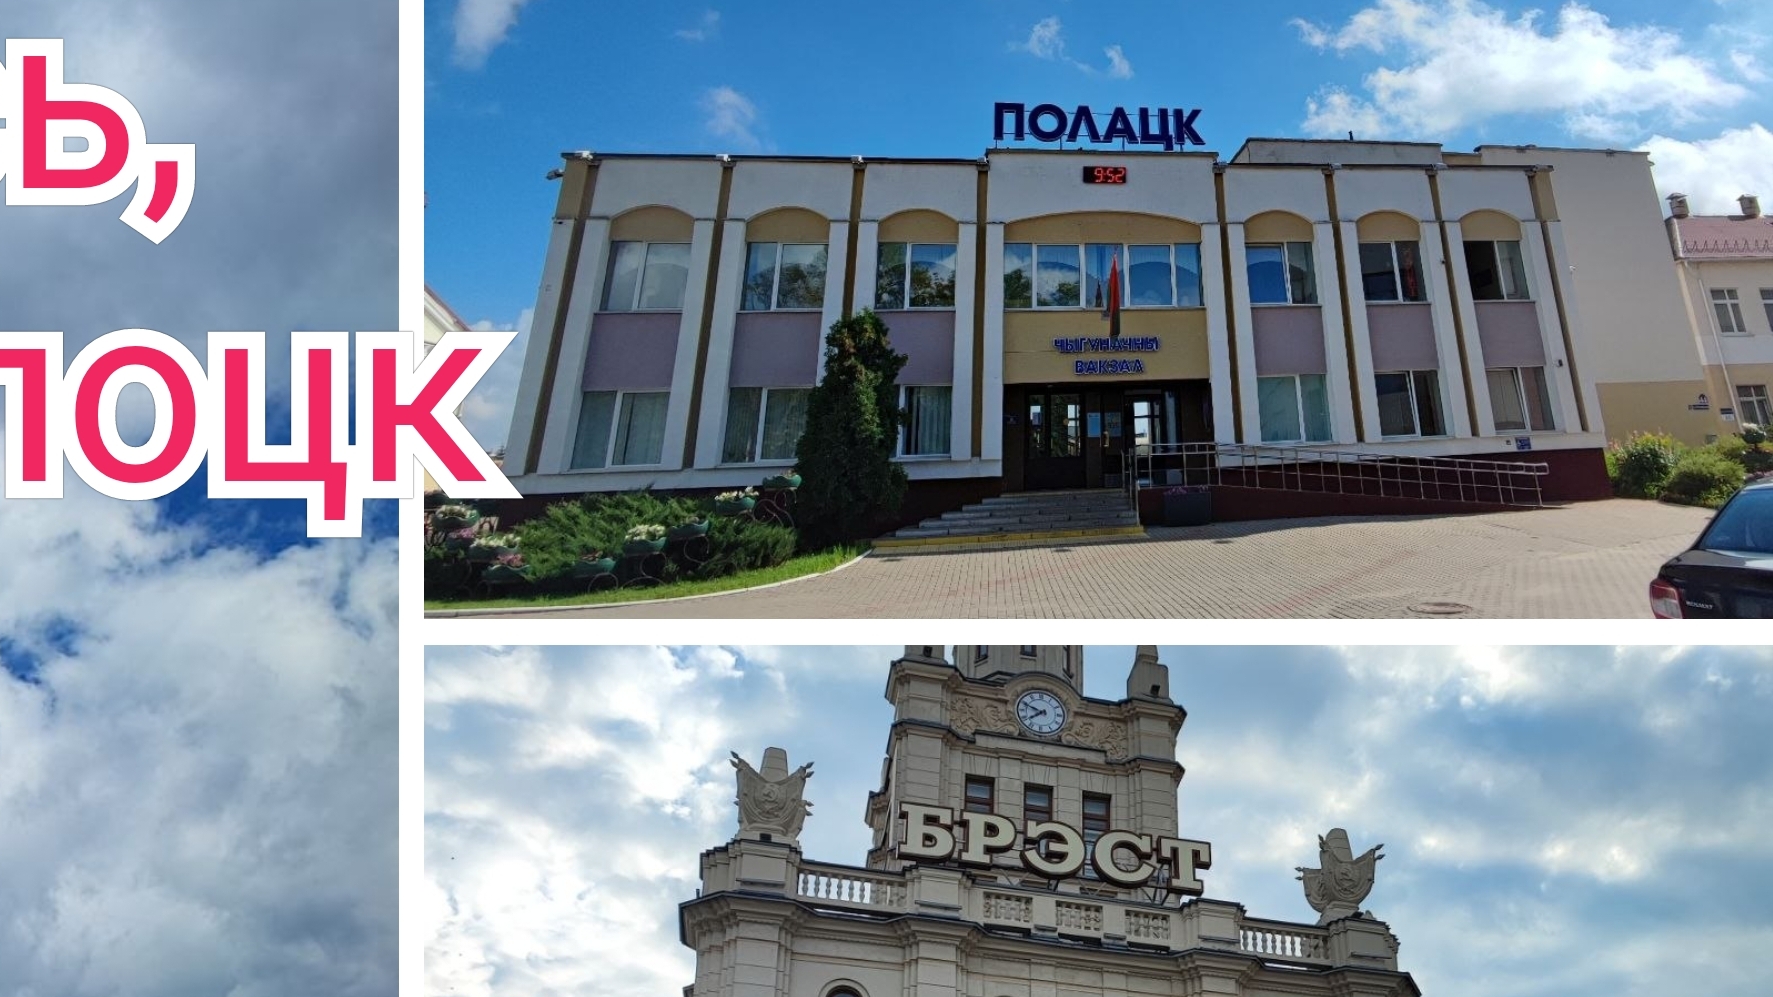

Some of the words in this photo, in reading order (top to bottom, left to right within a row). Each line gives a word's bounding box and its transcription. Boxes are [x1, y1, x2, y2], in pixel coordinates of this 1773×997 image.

[993, 101, 1206, 151] ПОЛАЦК
[1053, 336, 1160, 353] ЧЫГУНАЧНЫ
[1074, 359, 1145, 375] ВАКЗАЛ
[897, 801, 1212, 897] БРЭСТ
